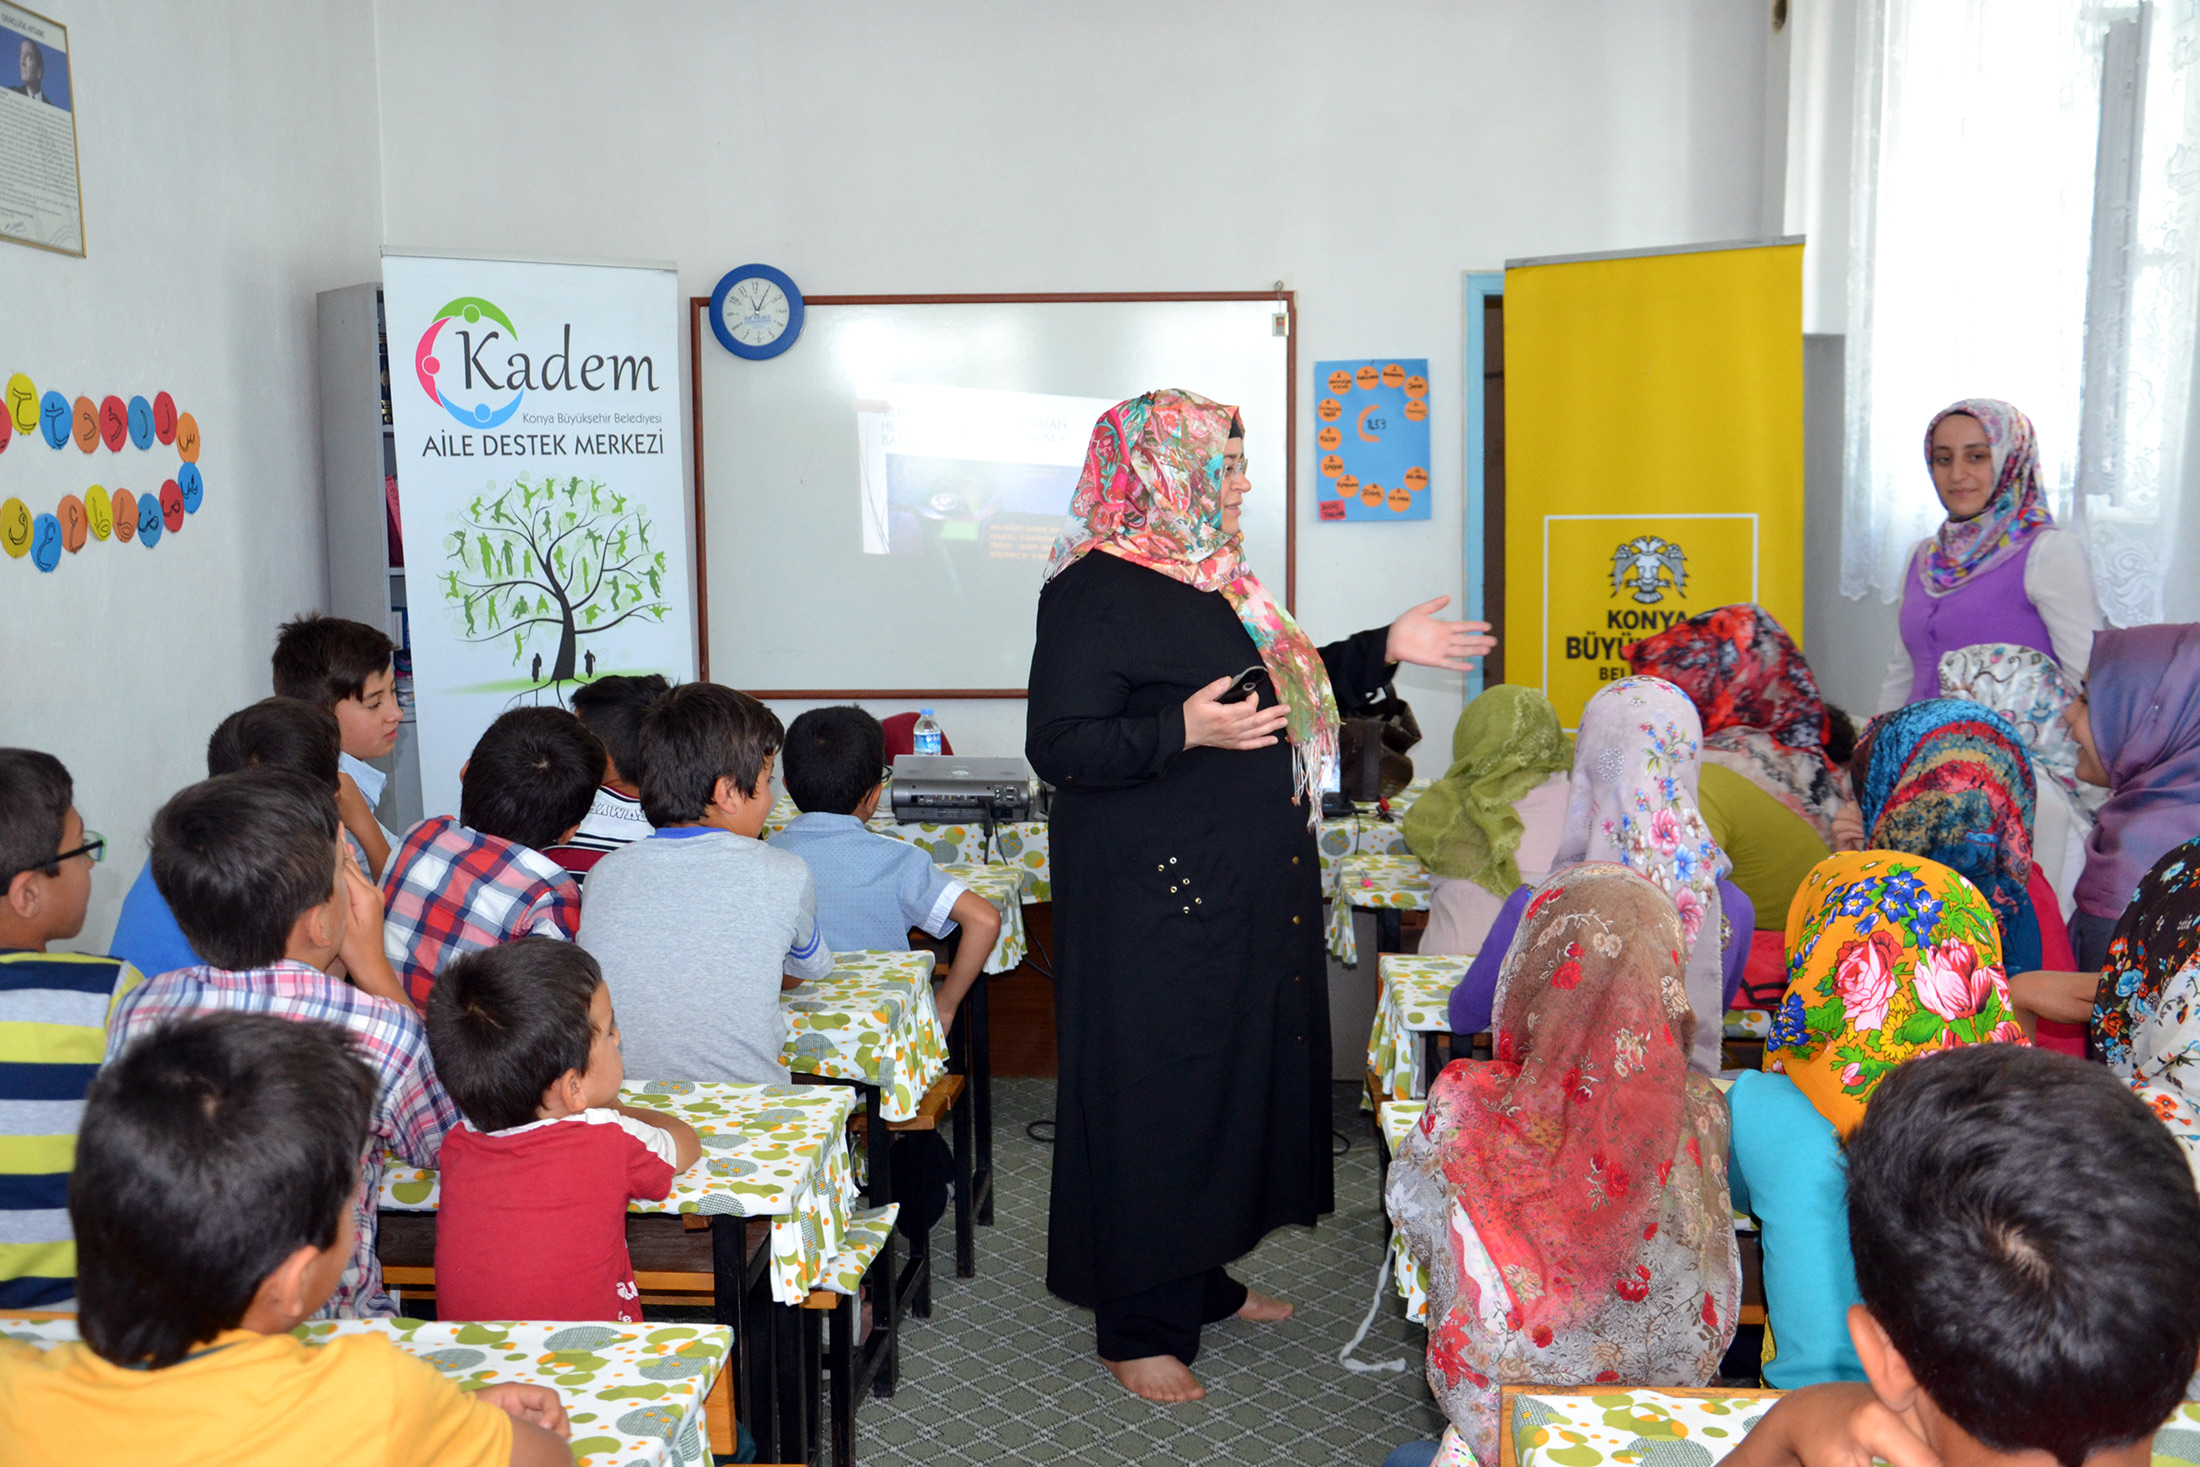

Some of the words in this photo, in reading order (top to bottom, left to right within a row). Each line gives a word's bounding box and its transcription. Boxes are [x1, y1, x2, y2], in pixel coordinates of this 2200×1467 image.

[455, 323, 661, 392] Kadem
[522, 413, 555, 426] Konya
[557, 412, 611, 425] Büyükşehir
[614, 412, 662, 425] Belediyesi
[422, 429, 475, 457] AİLE
[483, 434, 567, 456] DESTEK
[575, 428, 664, 455] MERKEZİ
[1607, 610, 1687, 630] KONYA
[1566, 631, 1643, 661] BÜYÜ
[1599, 667, 1628, 681] BEL
